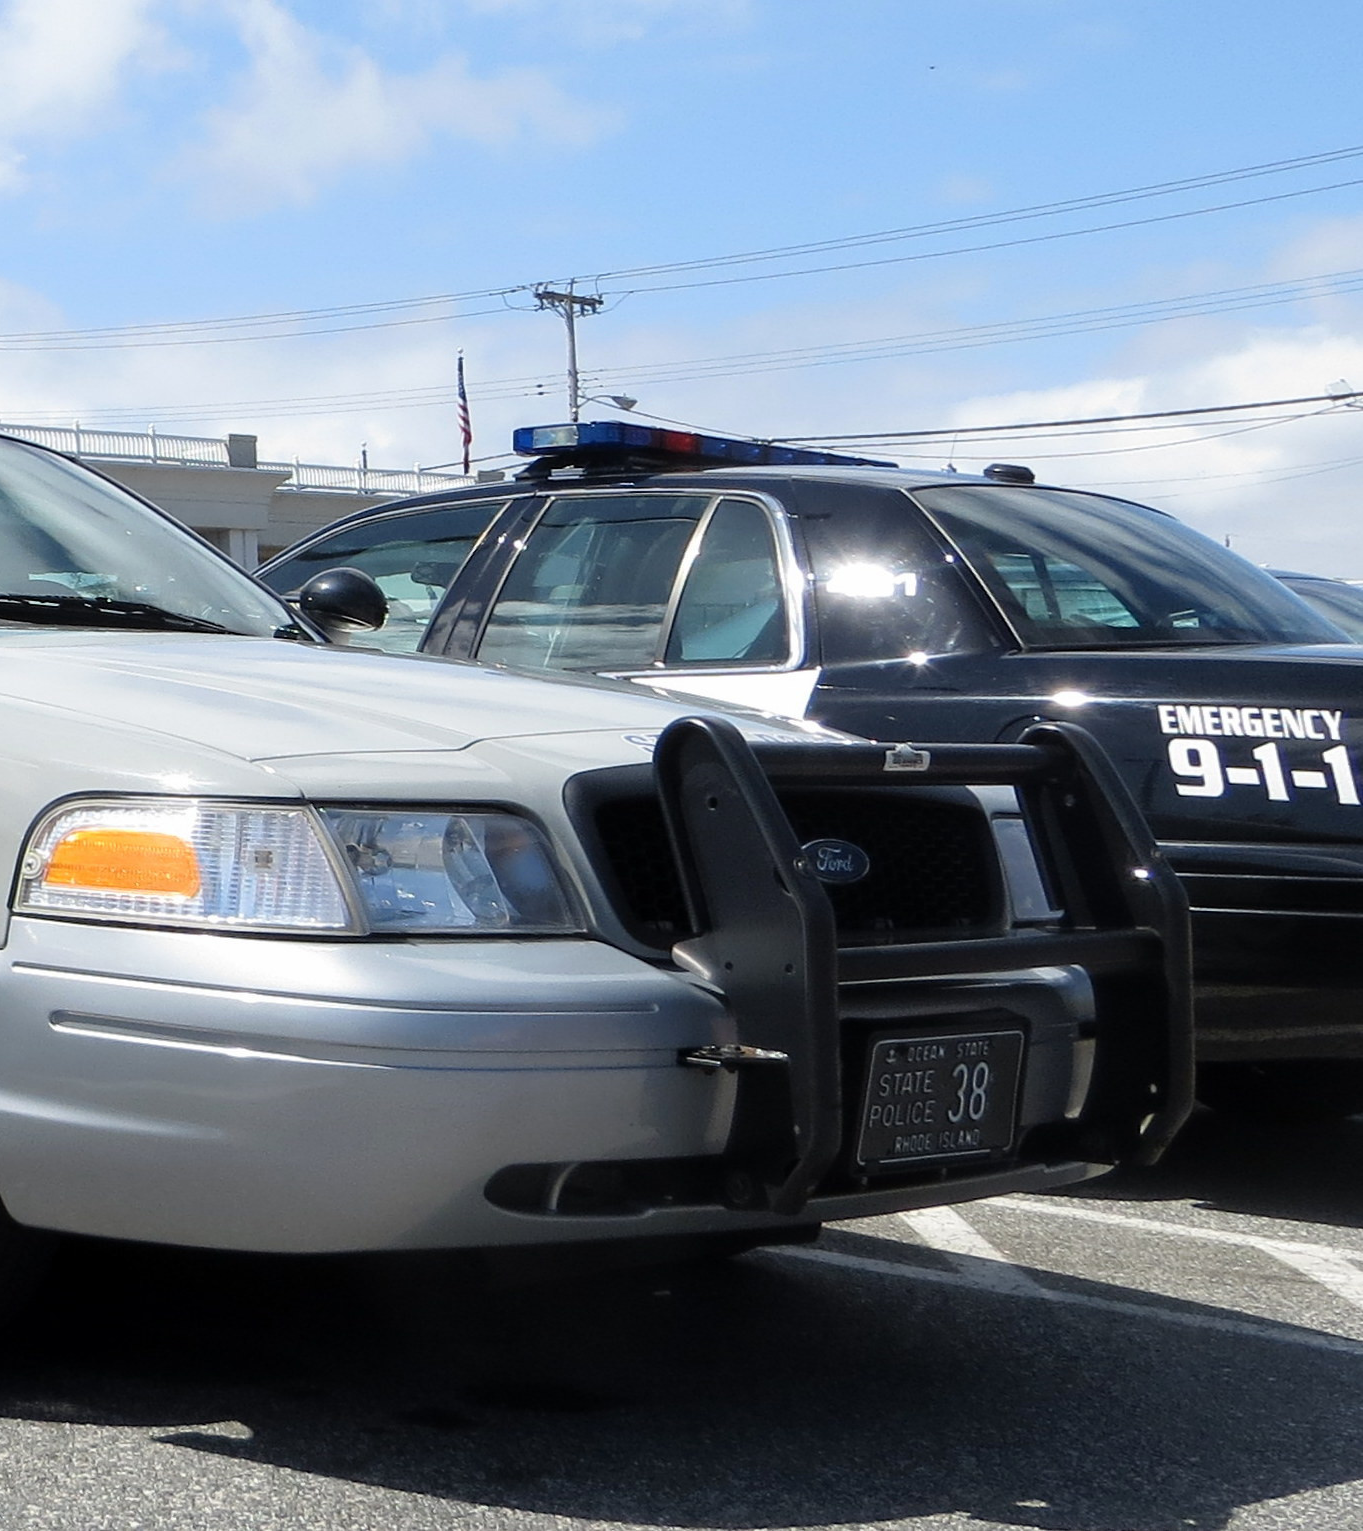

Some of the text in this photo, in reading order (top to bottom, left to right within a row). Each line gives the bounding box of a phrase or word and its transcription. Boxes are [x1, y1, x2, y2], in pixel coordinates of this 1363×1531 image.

[1157, 704, 1342, 740] EMERGENCY
[1168, 738, 1361, 806] 9-1-1
[817, 847, 855, 872] Ford
[907, 1041, 990, 1062] OCEAN STATE
[879, 1061, 989, 1123] STATE 38
[869, 1101, 936, 1127] POLICE
[894, 1129, 980, 1154] RHODE ISLAND
